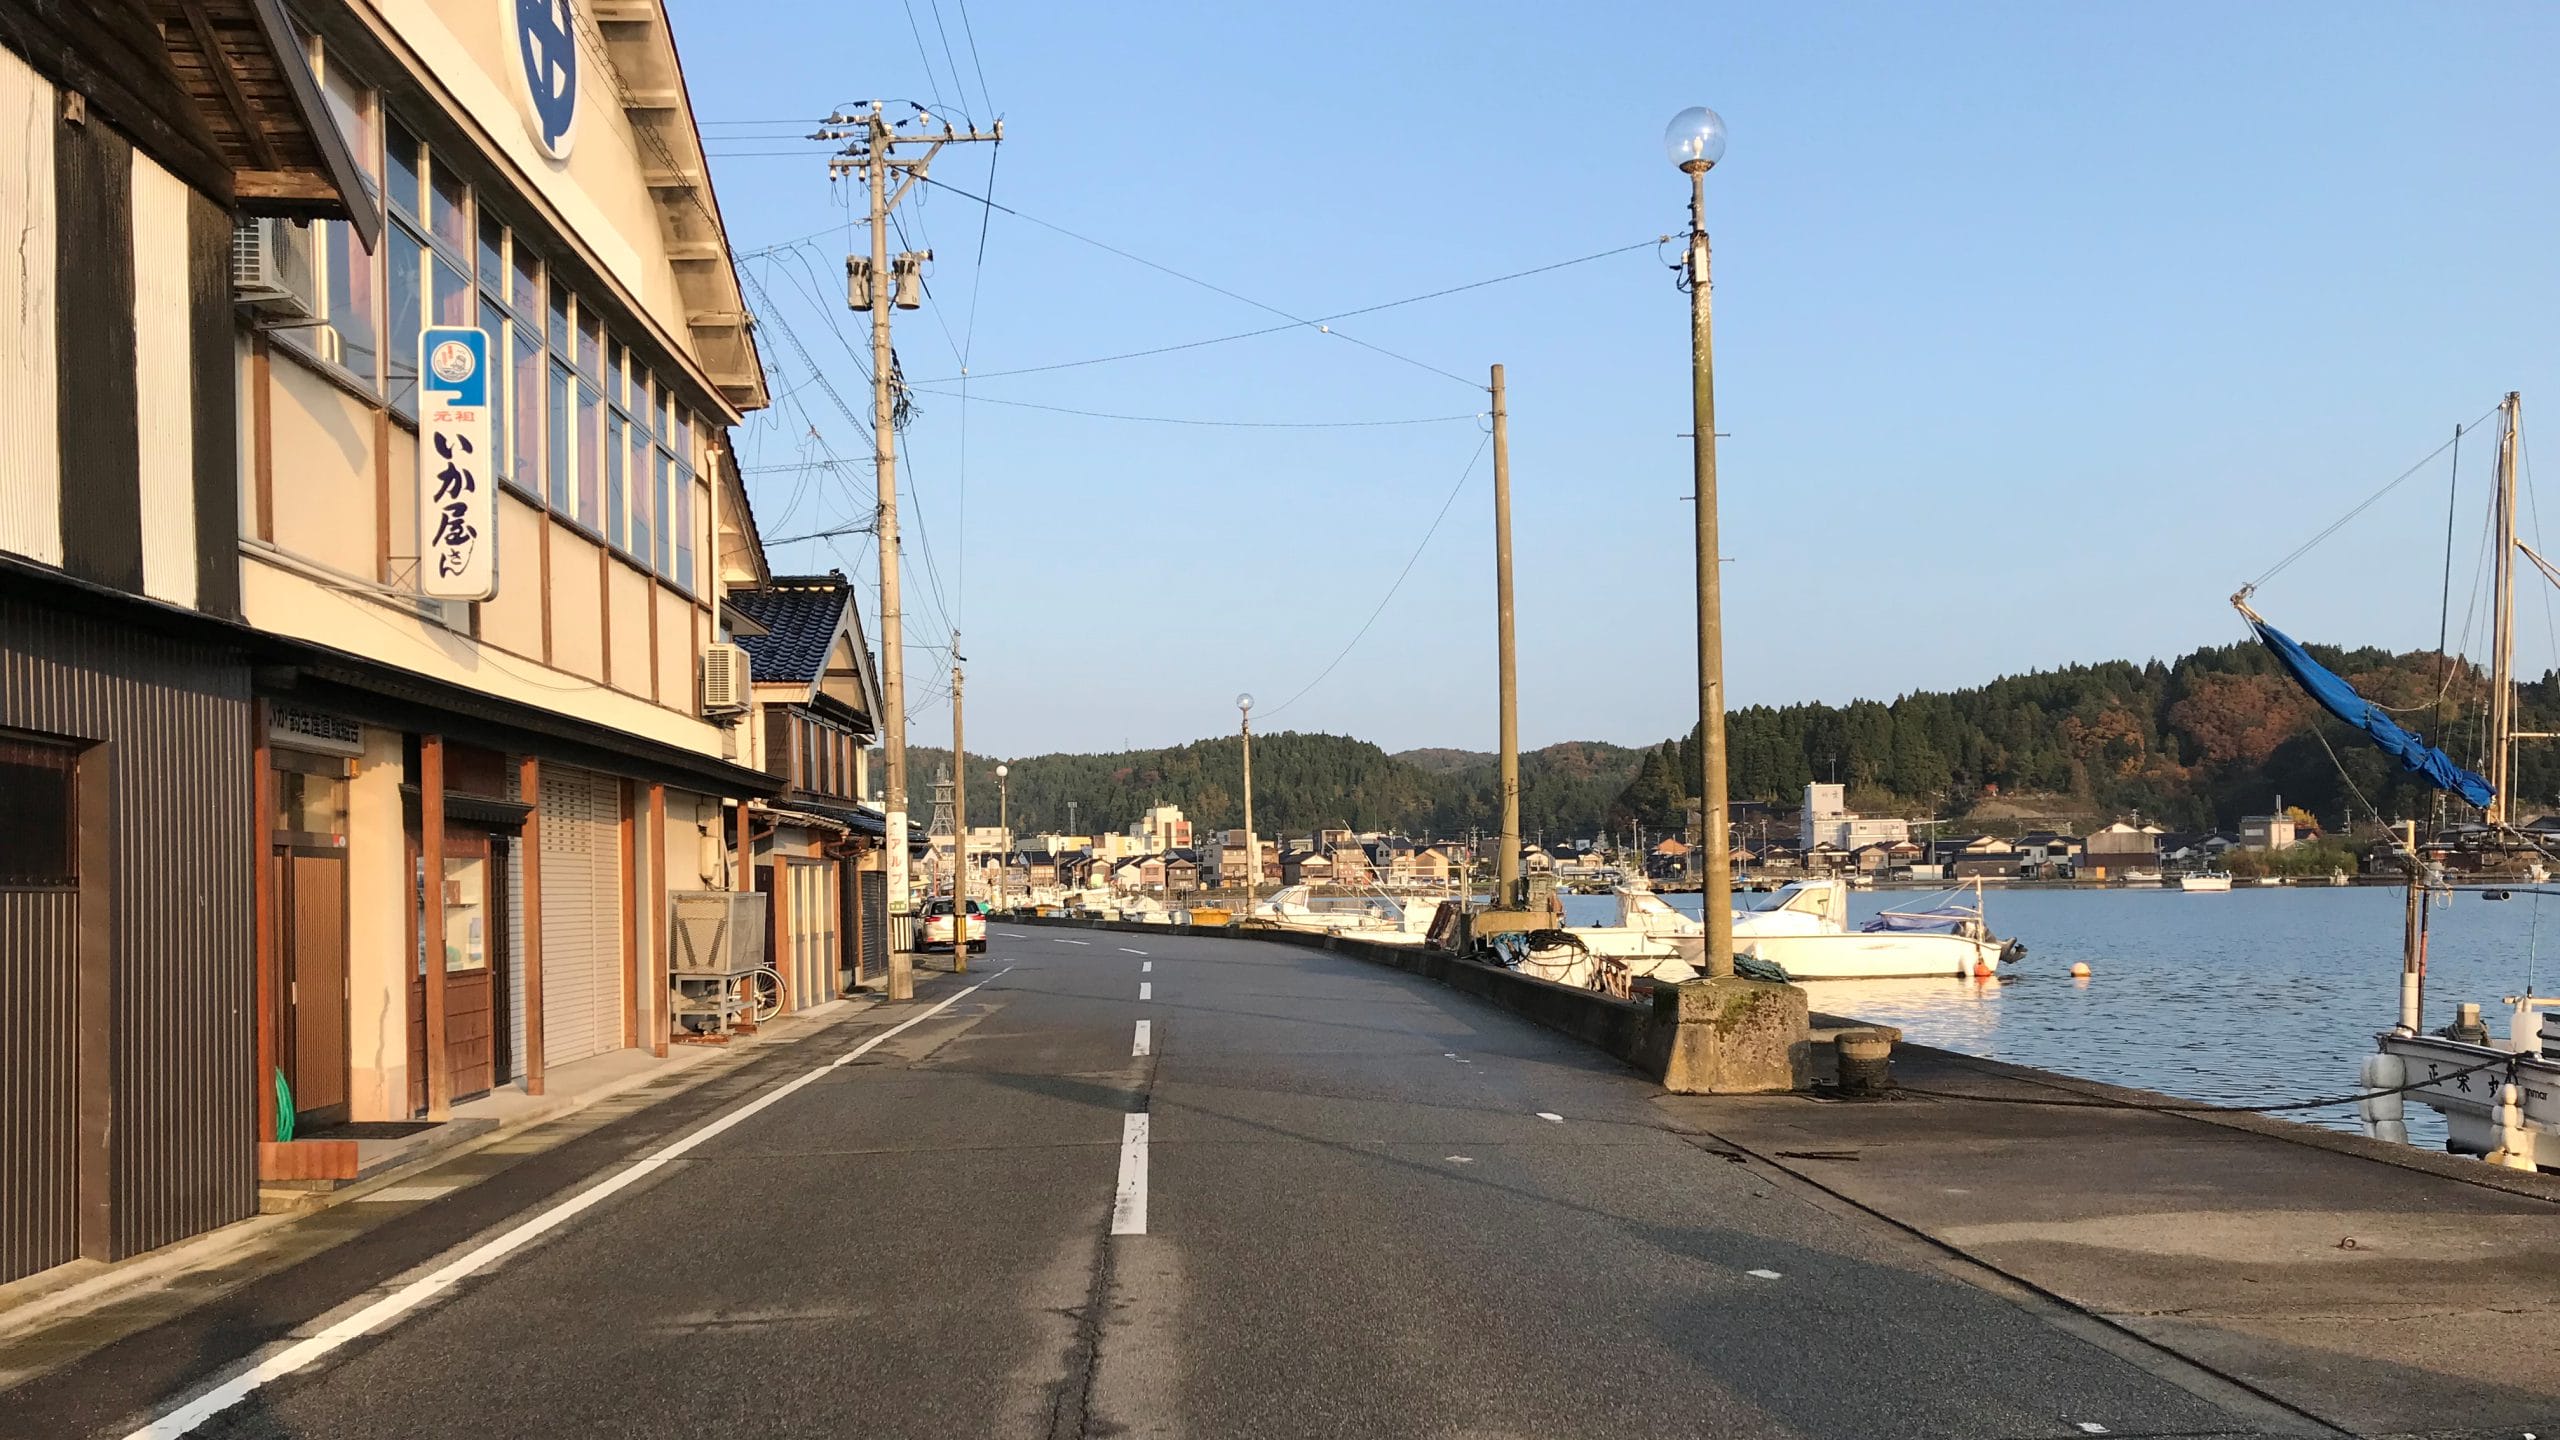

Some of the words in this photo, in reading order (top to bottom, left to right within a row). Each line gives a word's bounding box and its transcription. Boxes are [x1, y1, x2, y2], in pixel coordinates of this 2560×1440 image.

[433, 410, 476, 423] 元祖
[432, 431, 477, 578] いか屋さん
